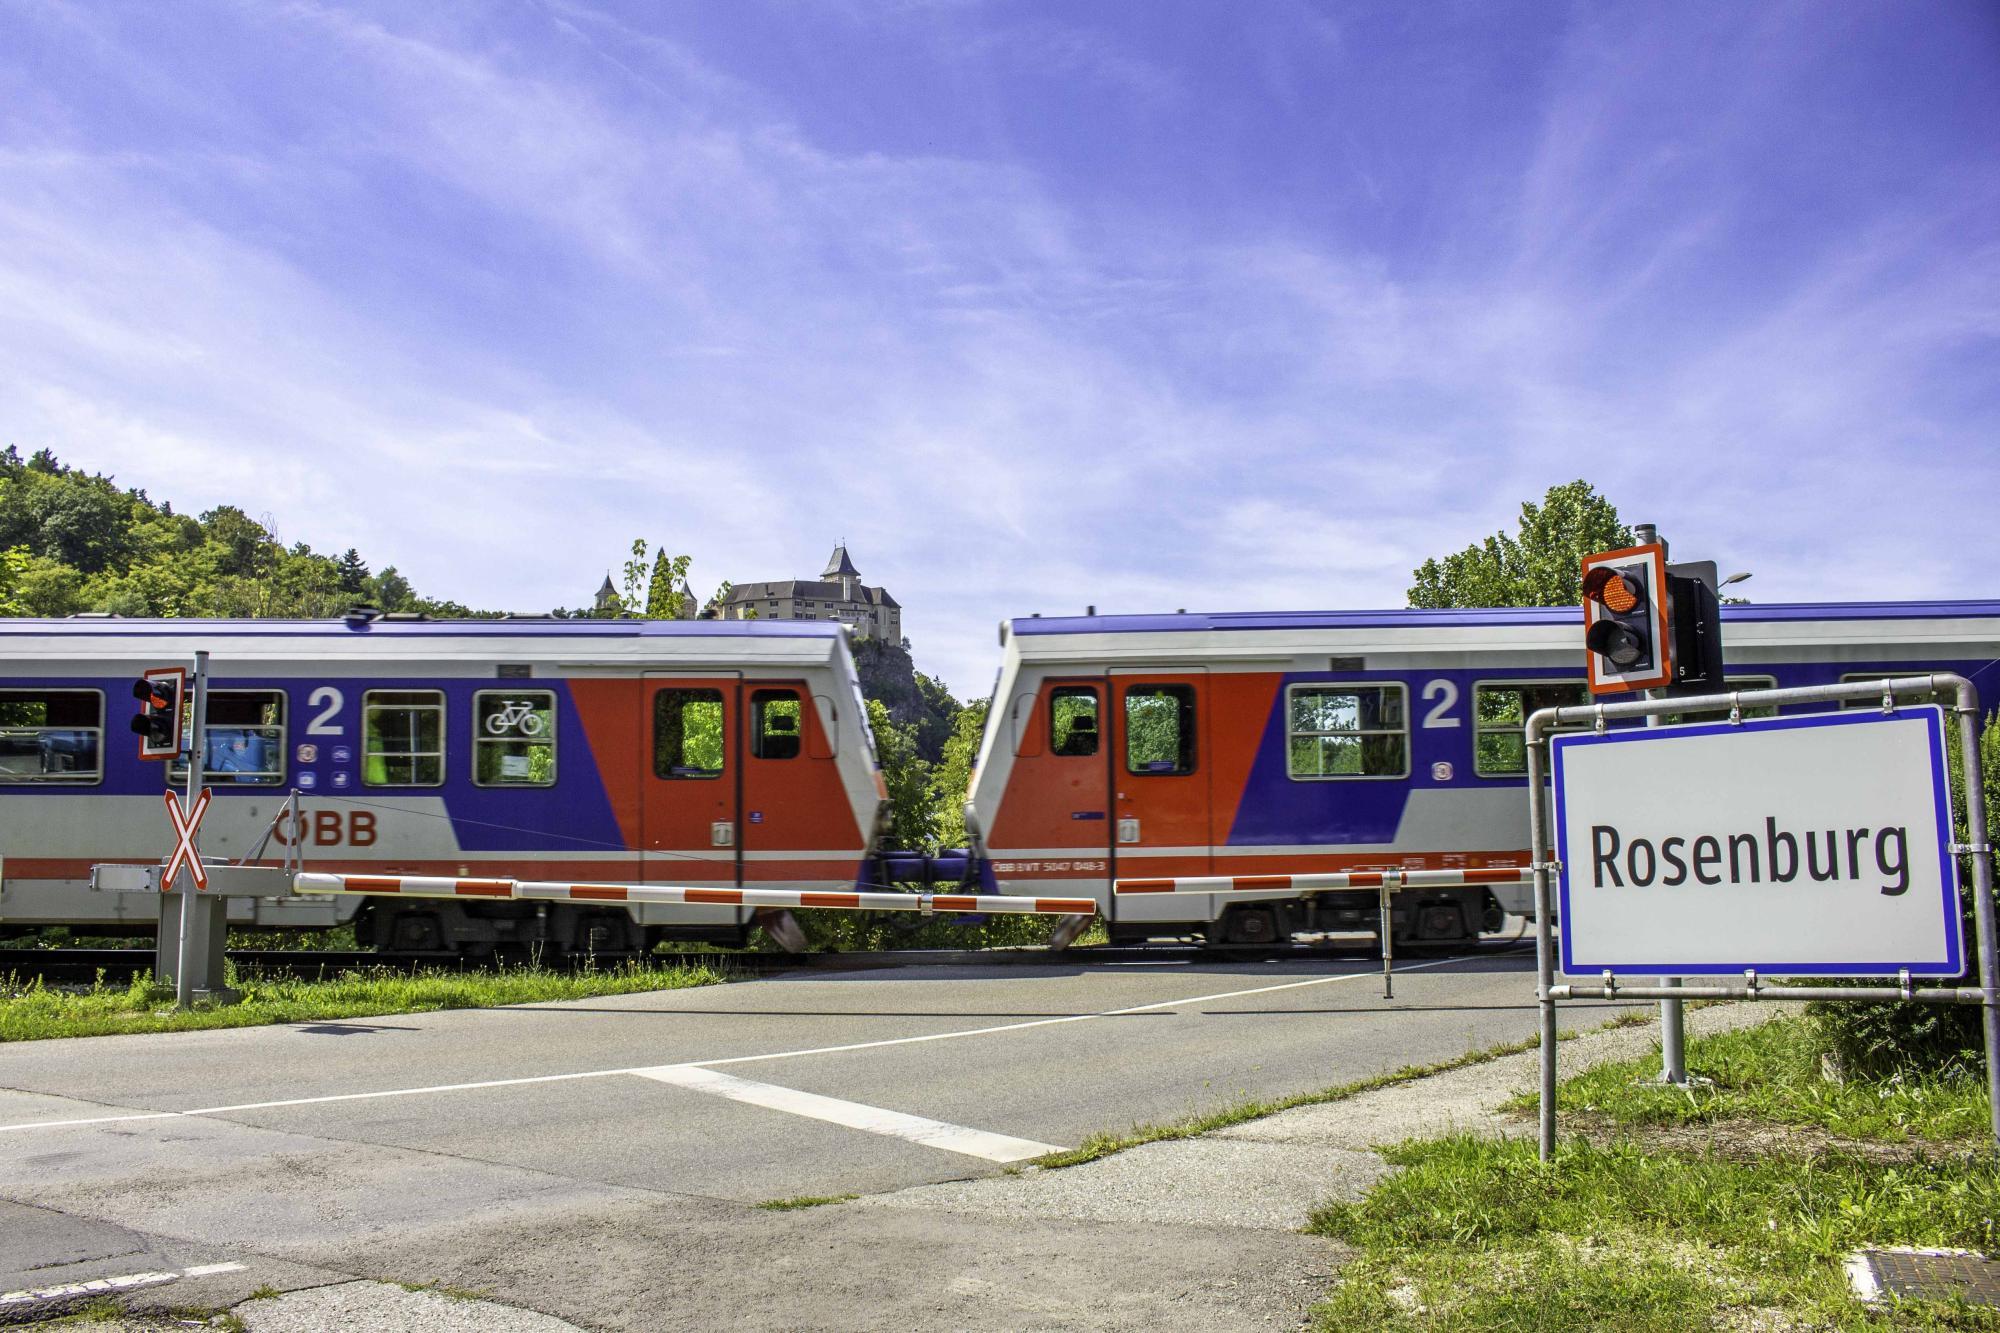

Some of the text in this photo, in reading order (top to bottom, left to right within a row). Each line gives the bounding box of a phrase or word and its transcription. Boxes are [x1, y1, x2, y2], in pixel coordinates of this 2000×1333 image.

[1680, 666, 1685, 676] 5
[306, 686, 344, 735] 2
[1422, 679, 1460, 728] 2
[273, 809, 377, 847] ÖBB
[1592, 816, 1910, 896] Rosenburg
